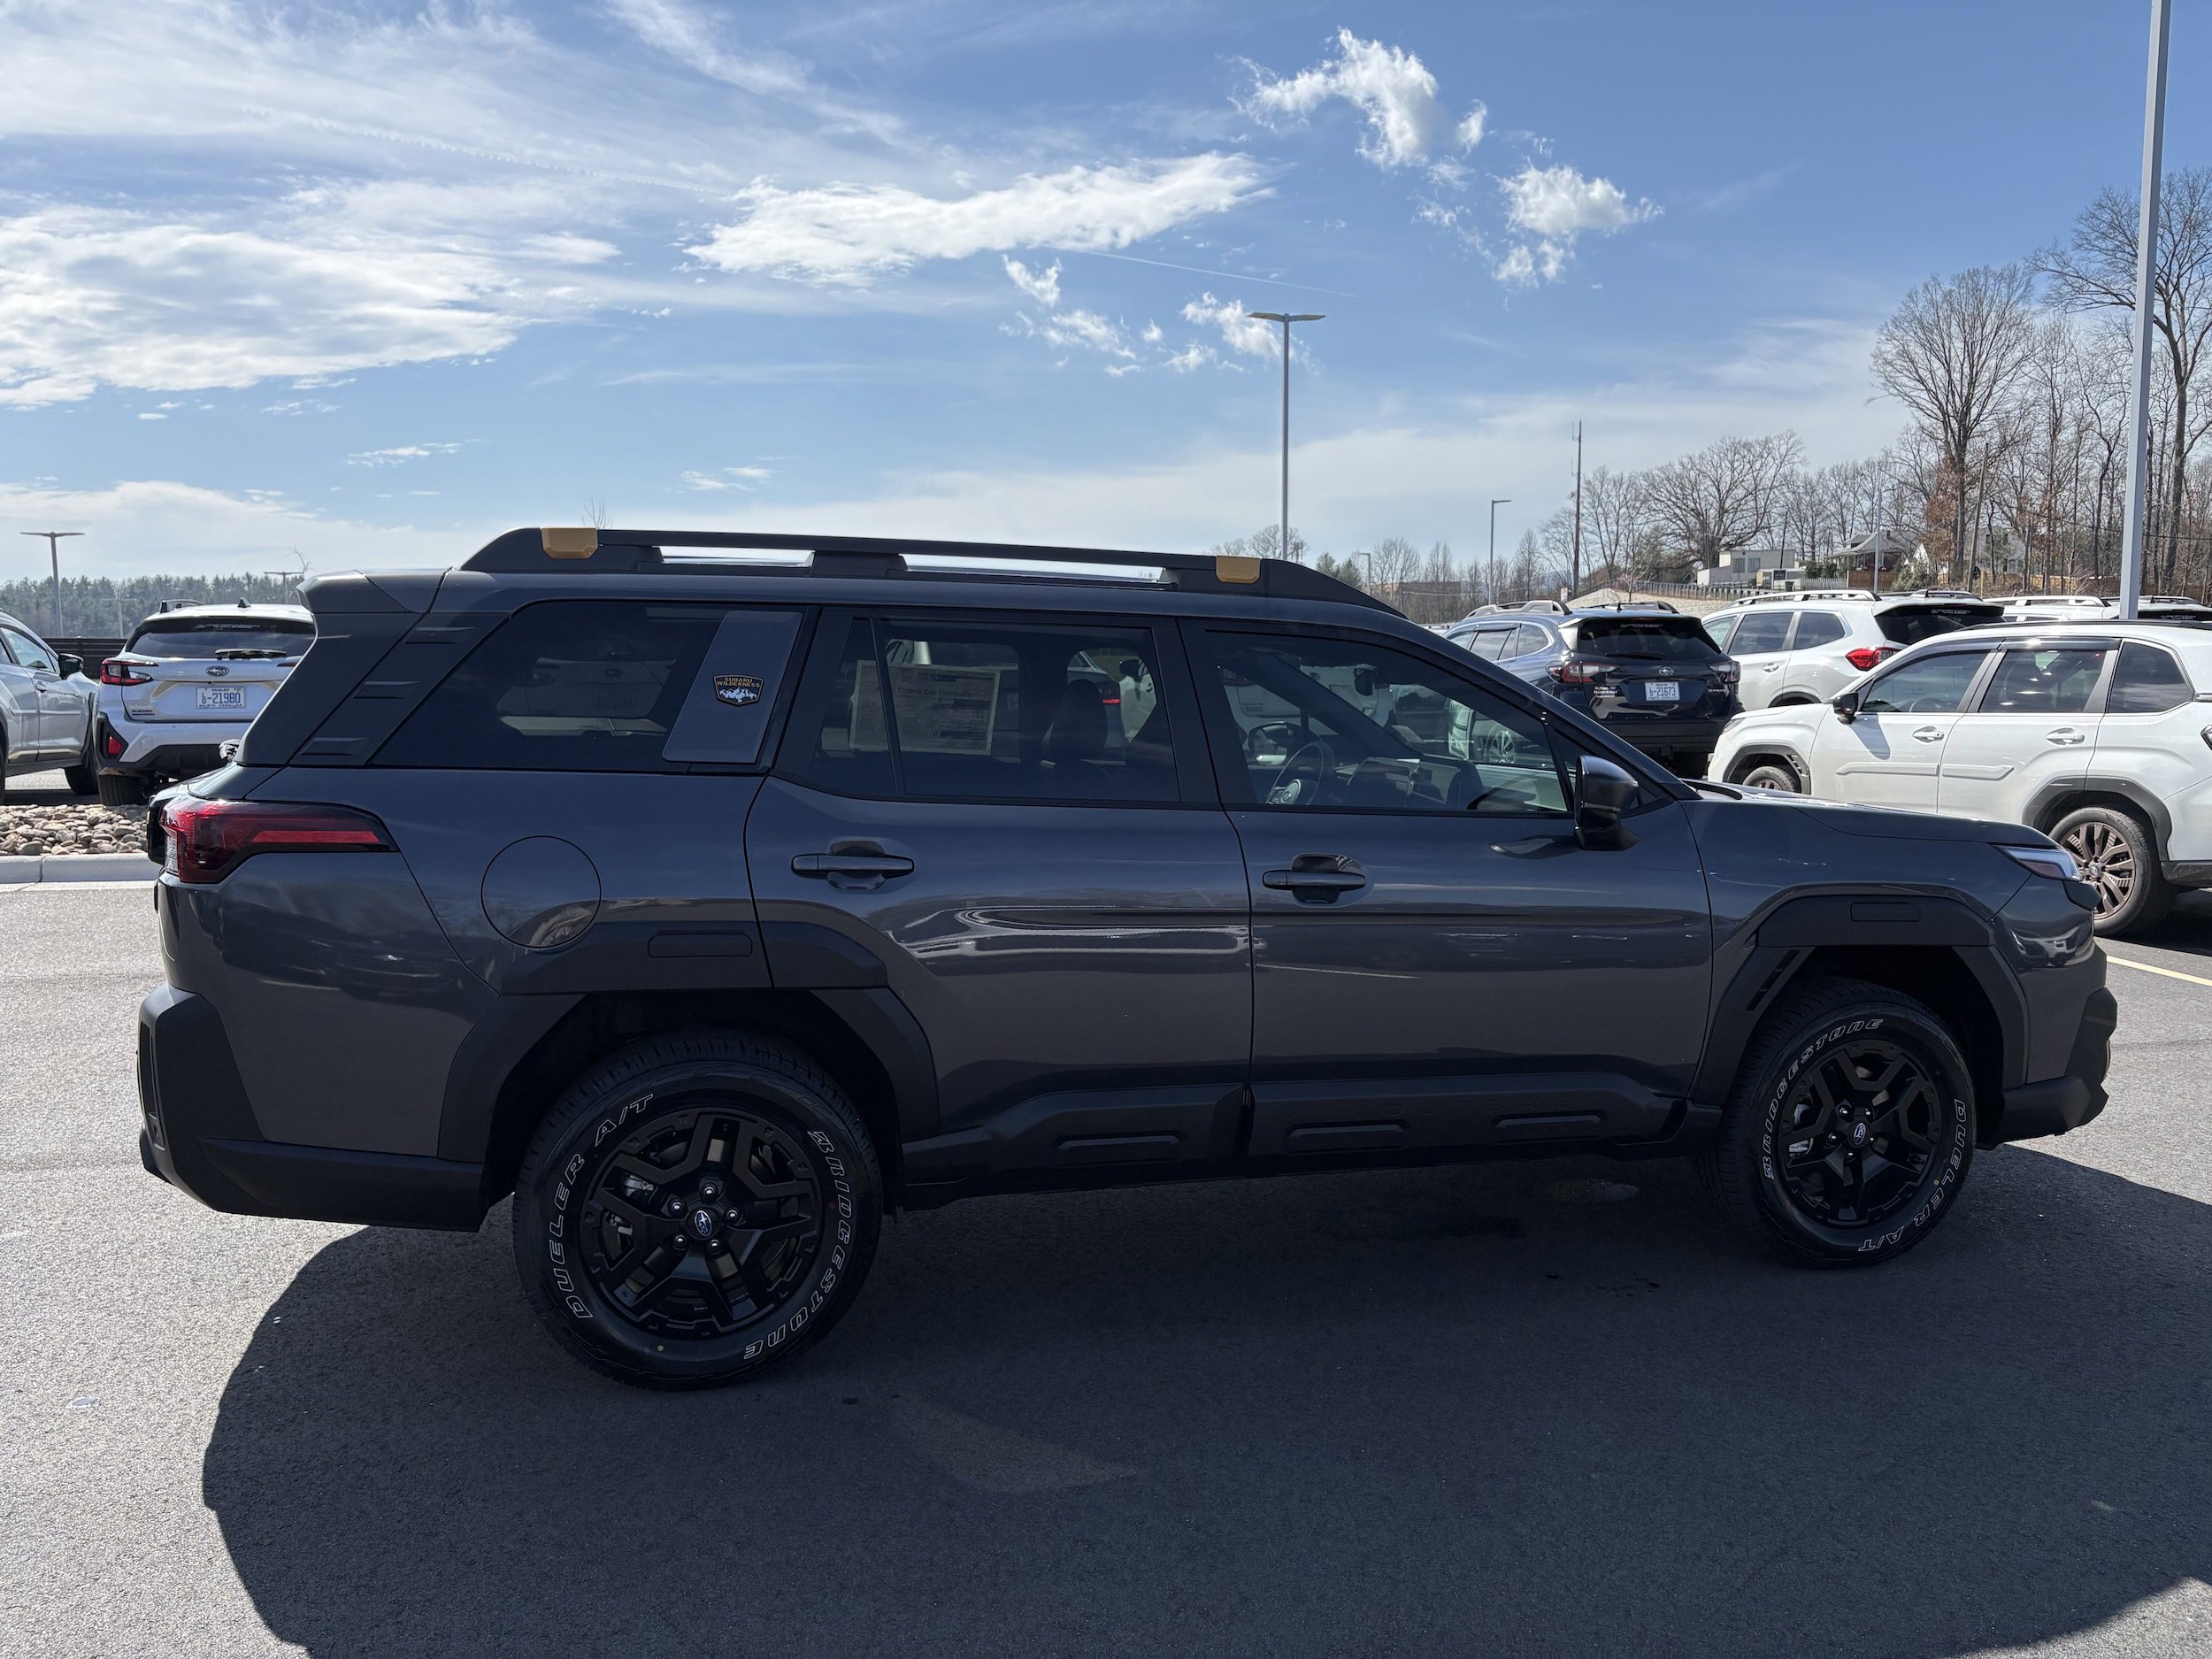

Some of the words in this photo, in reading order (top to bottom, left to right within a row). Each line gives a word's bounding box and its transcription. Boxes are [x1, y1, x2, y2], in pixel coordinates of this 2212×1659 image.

[1762, 1018, 1884, 1180] BRIDGESTONE
[1913, 1097, 1968, 1227] DUELER
[549, 1153, 595, 1319] DUELER
[594, 1093, 654, 1148] A/T
[742, 1130, 853, 1360] BRIDGESTONE
[1857, 1225, 1905, 1252] A/T
